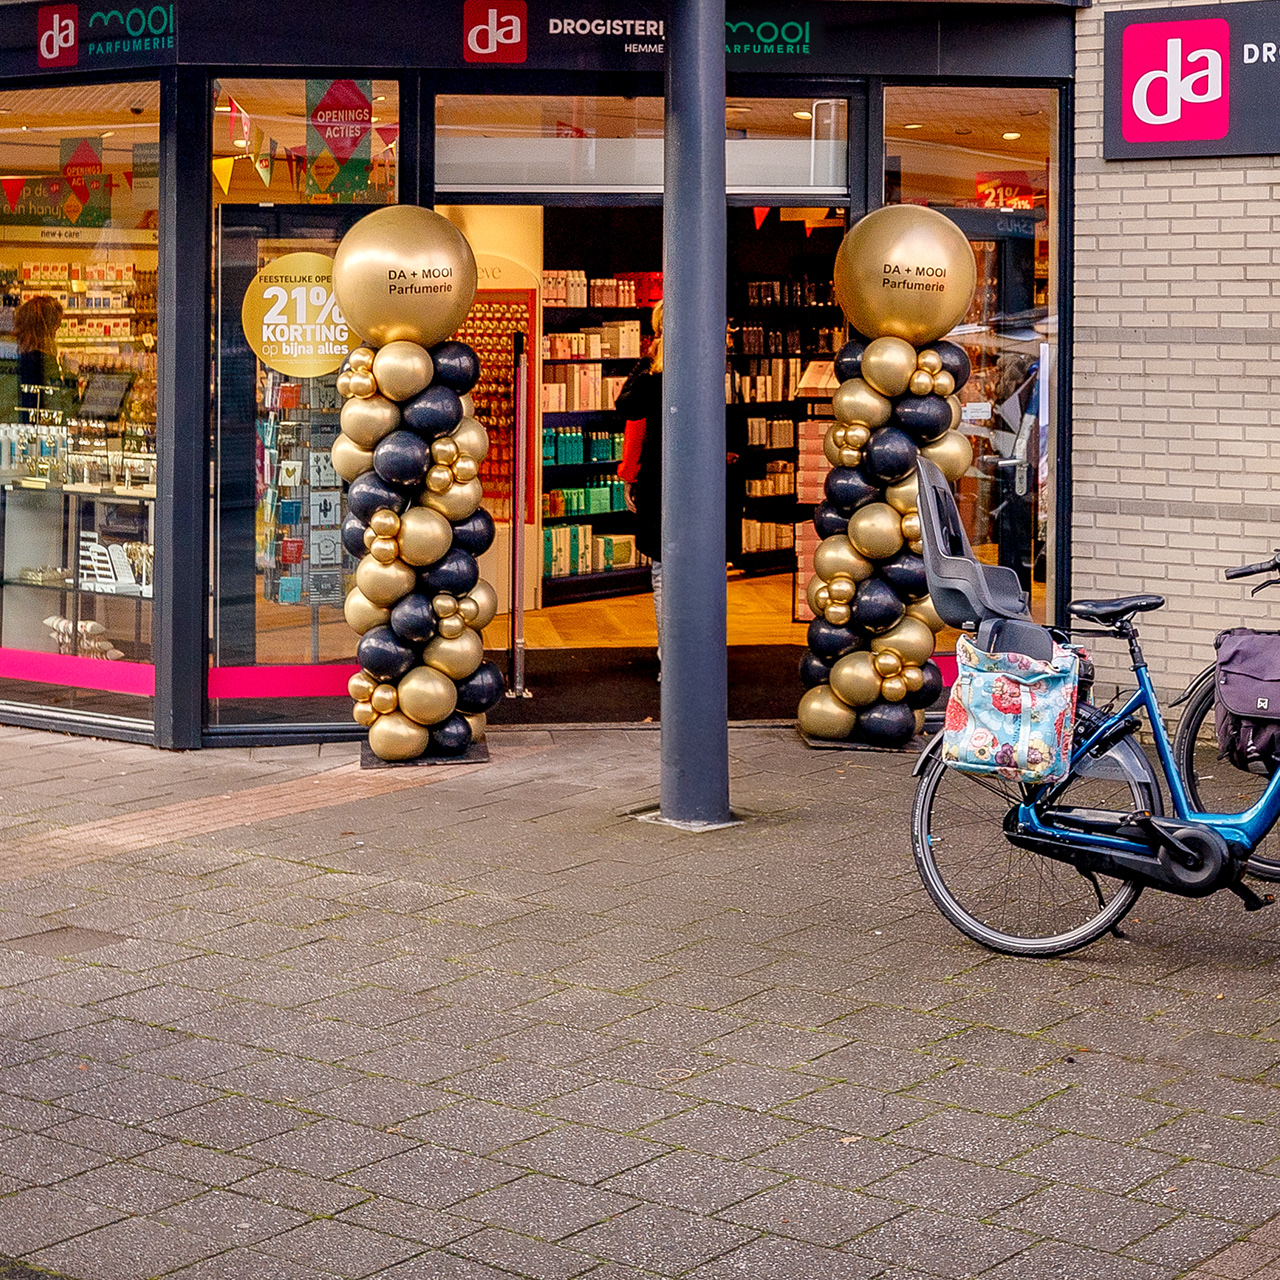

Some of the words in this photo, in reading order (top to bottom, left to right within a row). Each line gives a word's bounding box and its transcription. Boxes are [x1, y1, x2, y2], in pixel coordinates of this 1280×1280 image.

[40, 13, 75, 59] da
[467, 8, 521, 55] da
[548, 18, 666, 41] DROGISTERI
[88, 36, 175, 55] PARFUMERIE
[624, 43, 665, 54] HEMME
[724, 44, 811, 55] ARFUMERIE
[1132, 37, 1223, 126] da
[317, 108, 370, 123] OPENINGS
[325, 126, 362, 138] ACTIES
[388, 269, 407, 281] DA
[410, 271, 419, 279] +
[422, 267, 453, 280] MOOI
[883, 263, 901, 275] DA
[904, 265, 913, 276] +
[915, 266, 947, 279] MOOI
[258, 275, 313, 284] FEESTELIJKE
[314, 275, 332, 284] OPE
[882, 278, 945, 293] Parfumerie
[388, 282, 453, 296] Parfumerie
[262, 285, 347, 325] 21%
[261, 324, 349, 342] KORTING
[261, 344, 279, 358] op
[281, 341, 314, 358] bijna
[317, 341, 349, 356] alles
